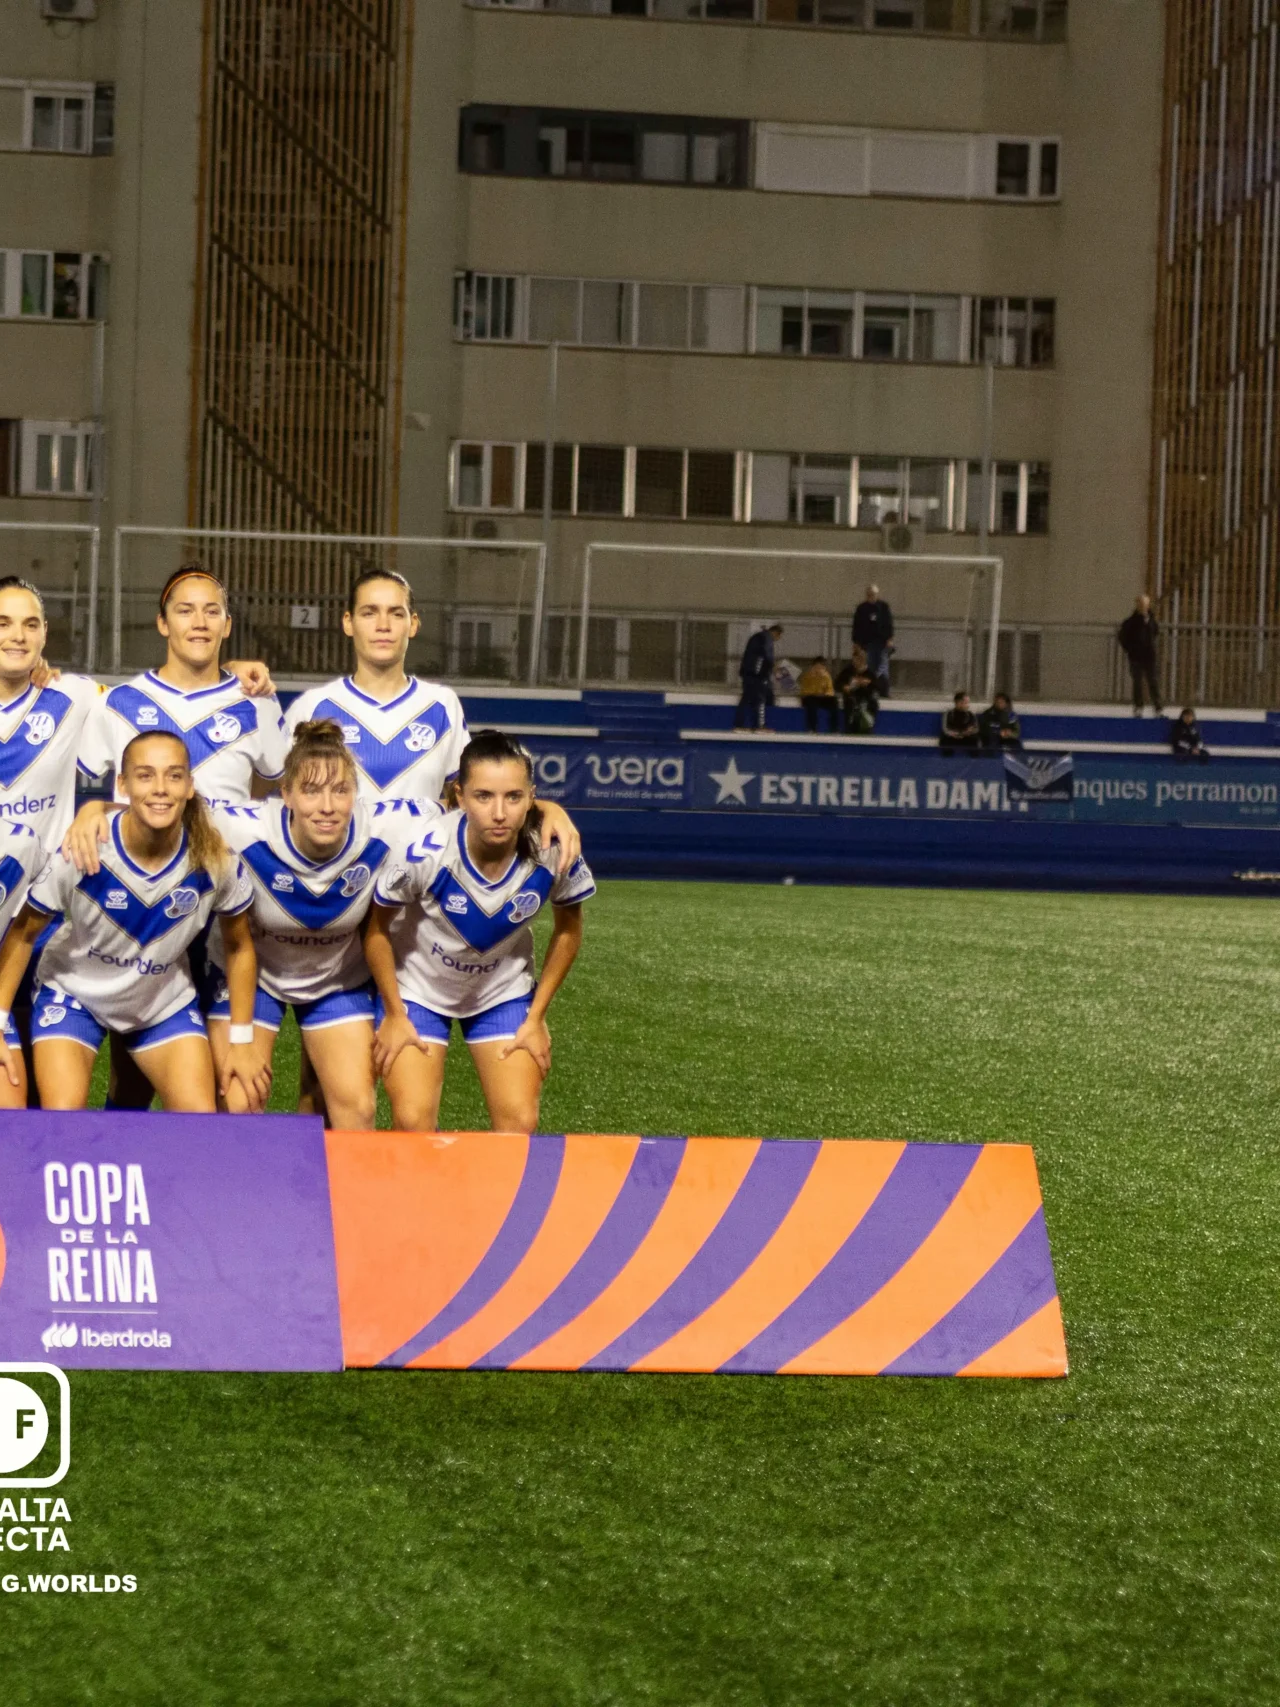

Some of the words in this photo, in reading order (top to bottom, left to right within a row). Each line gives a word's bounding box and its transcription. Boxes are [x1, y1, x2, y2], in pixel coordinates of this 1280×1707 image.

[299, 609, 310, 625] 2
[585, 752, 684, 786] vera
[761, 773, 918, 809] ESTRELLA
[1073, 780, 1147, 806] nques
[1155, 780, 1277, 807] perramon
[88, 945, 172, 975] Founder
[43, 1161, 151, 1226] COPA
[61, 1229, 95, 1244] DE
[106, 1229, 138, 1244] LA
[48, 1248, 158, 1304] REINA
[82, 1328, 172, 1349] Iberdrola
